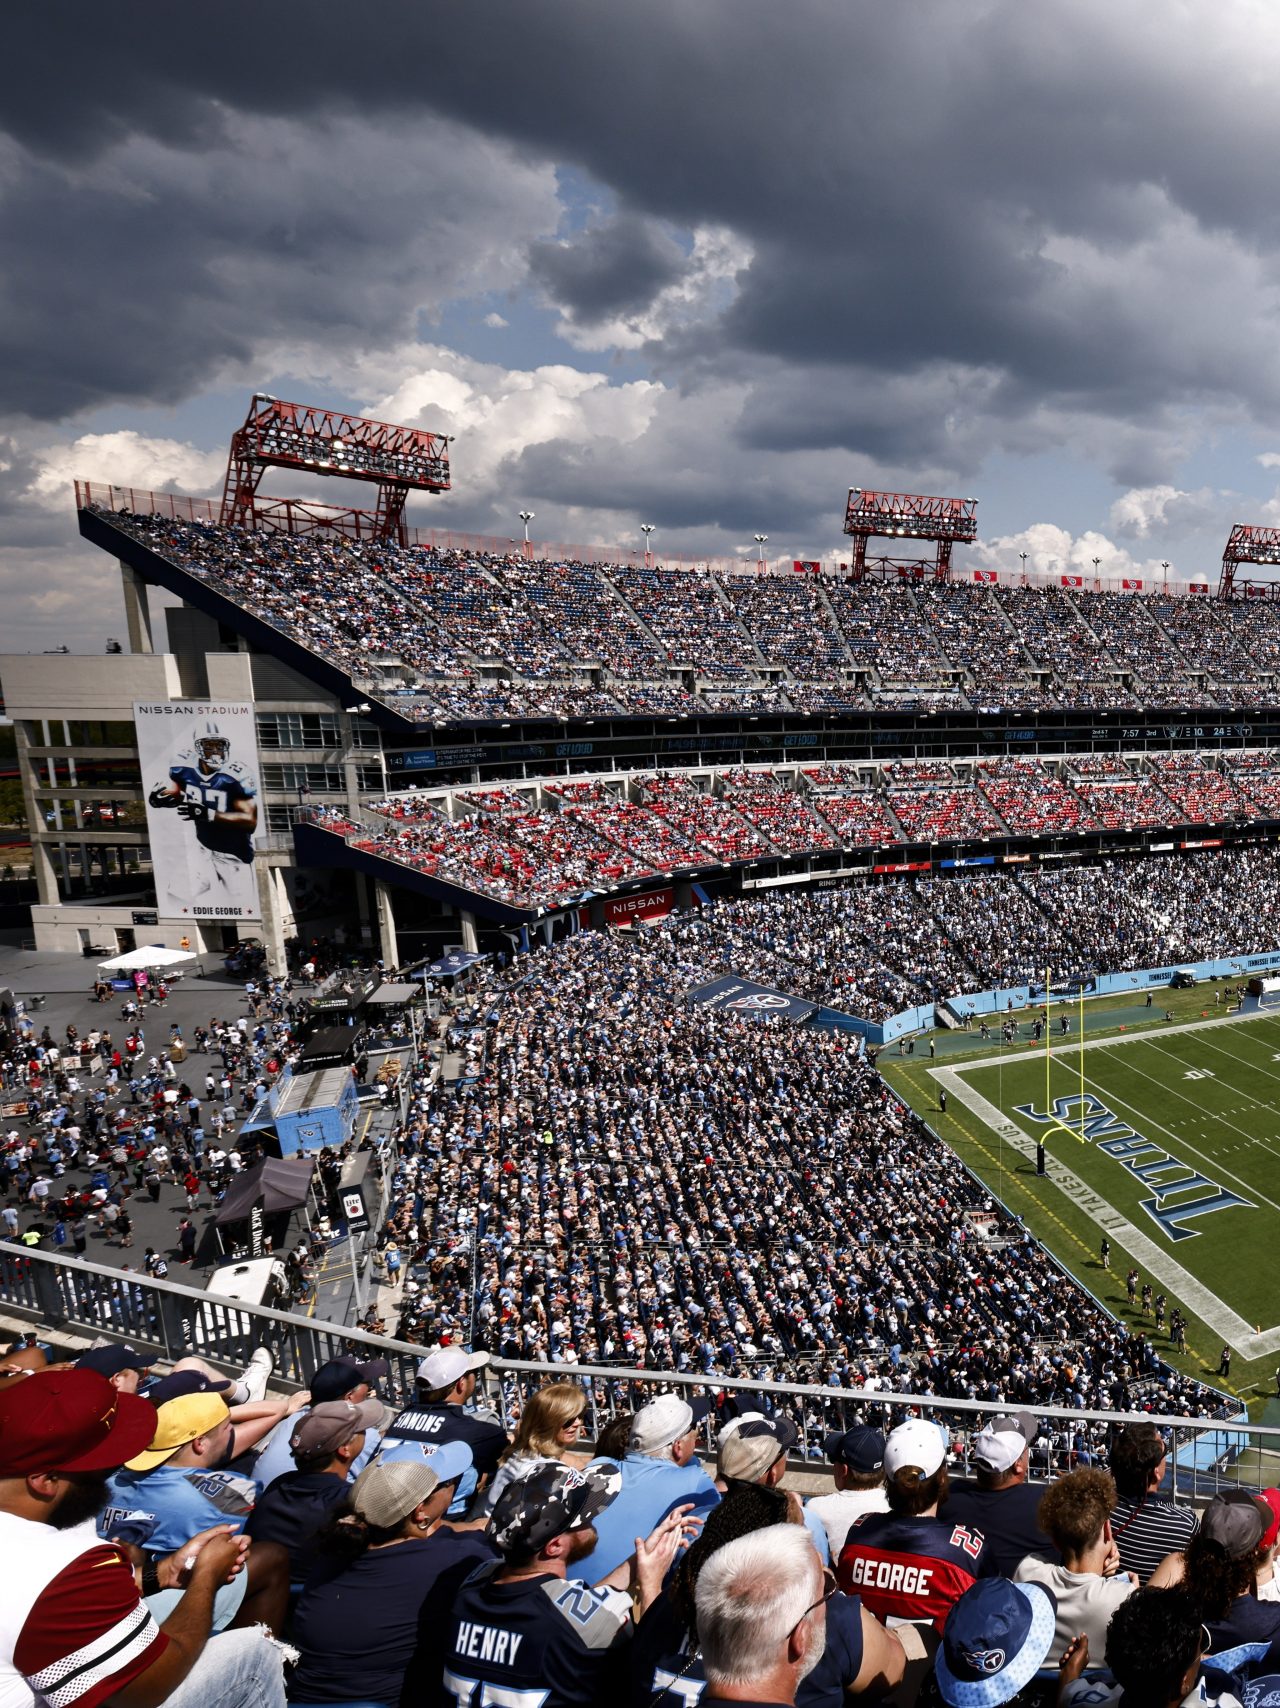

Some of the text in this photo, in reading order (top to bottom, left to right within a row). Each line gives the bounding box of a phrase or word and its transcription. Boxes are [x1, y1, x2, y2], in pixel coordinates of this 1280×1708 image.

[139, 706, 249, 715] NISSAN STADIUM
[1122, 729, 1139, 738] 7:57
[1193, 727, 1204, 736] 10
[1213, 727, 1224, 736] 24
[556, 743, 593, 756] GET LOUD
[390, 757, 403, 766] 1:43
[818, 879, 836, 887] RING
[193, 907, 242, 916] EDDIE GEORGE
[613, 896, 665, 914] NISSAN
[1248, 957, 1269, 967] TENNESSEE
[1148, 972, 1172, 983] TENNESSEE
[704, 985, 744, 1007] NISSAN
[1190, 1067, 1216, 1079] 10
[997, 1124, 1021, 1139] US
[1013, 1138, 1038, 1152] OF
[1012, 1093, 1260, 1243] TITANS
[1055, 1174, 1107, 1213] TAKES
[345, 1197, 360, 1207] Lite
[251, 1206, 263, 1230] JACK
[1101, 1216, 1128, 1231] IT
[852, 1557, 934, 1596] GEORGE
[455, 1620, 524, 1667] HENRY
